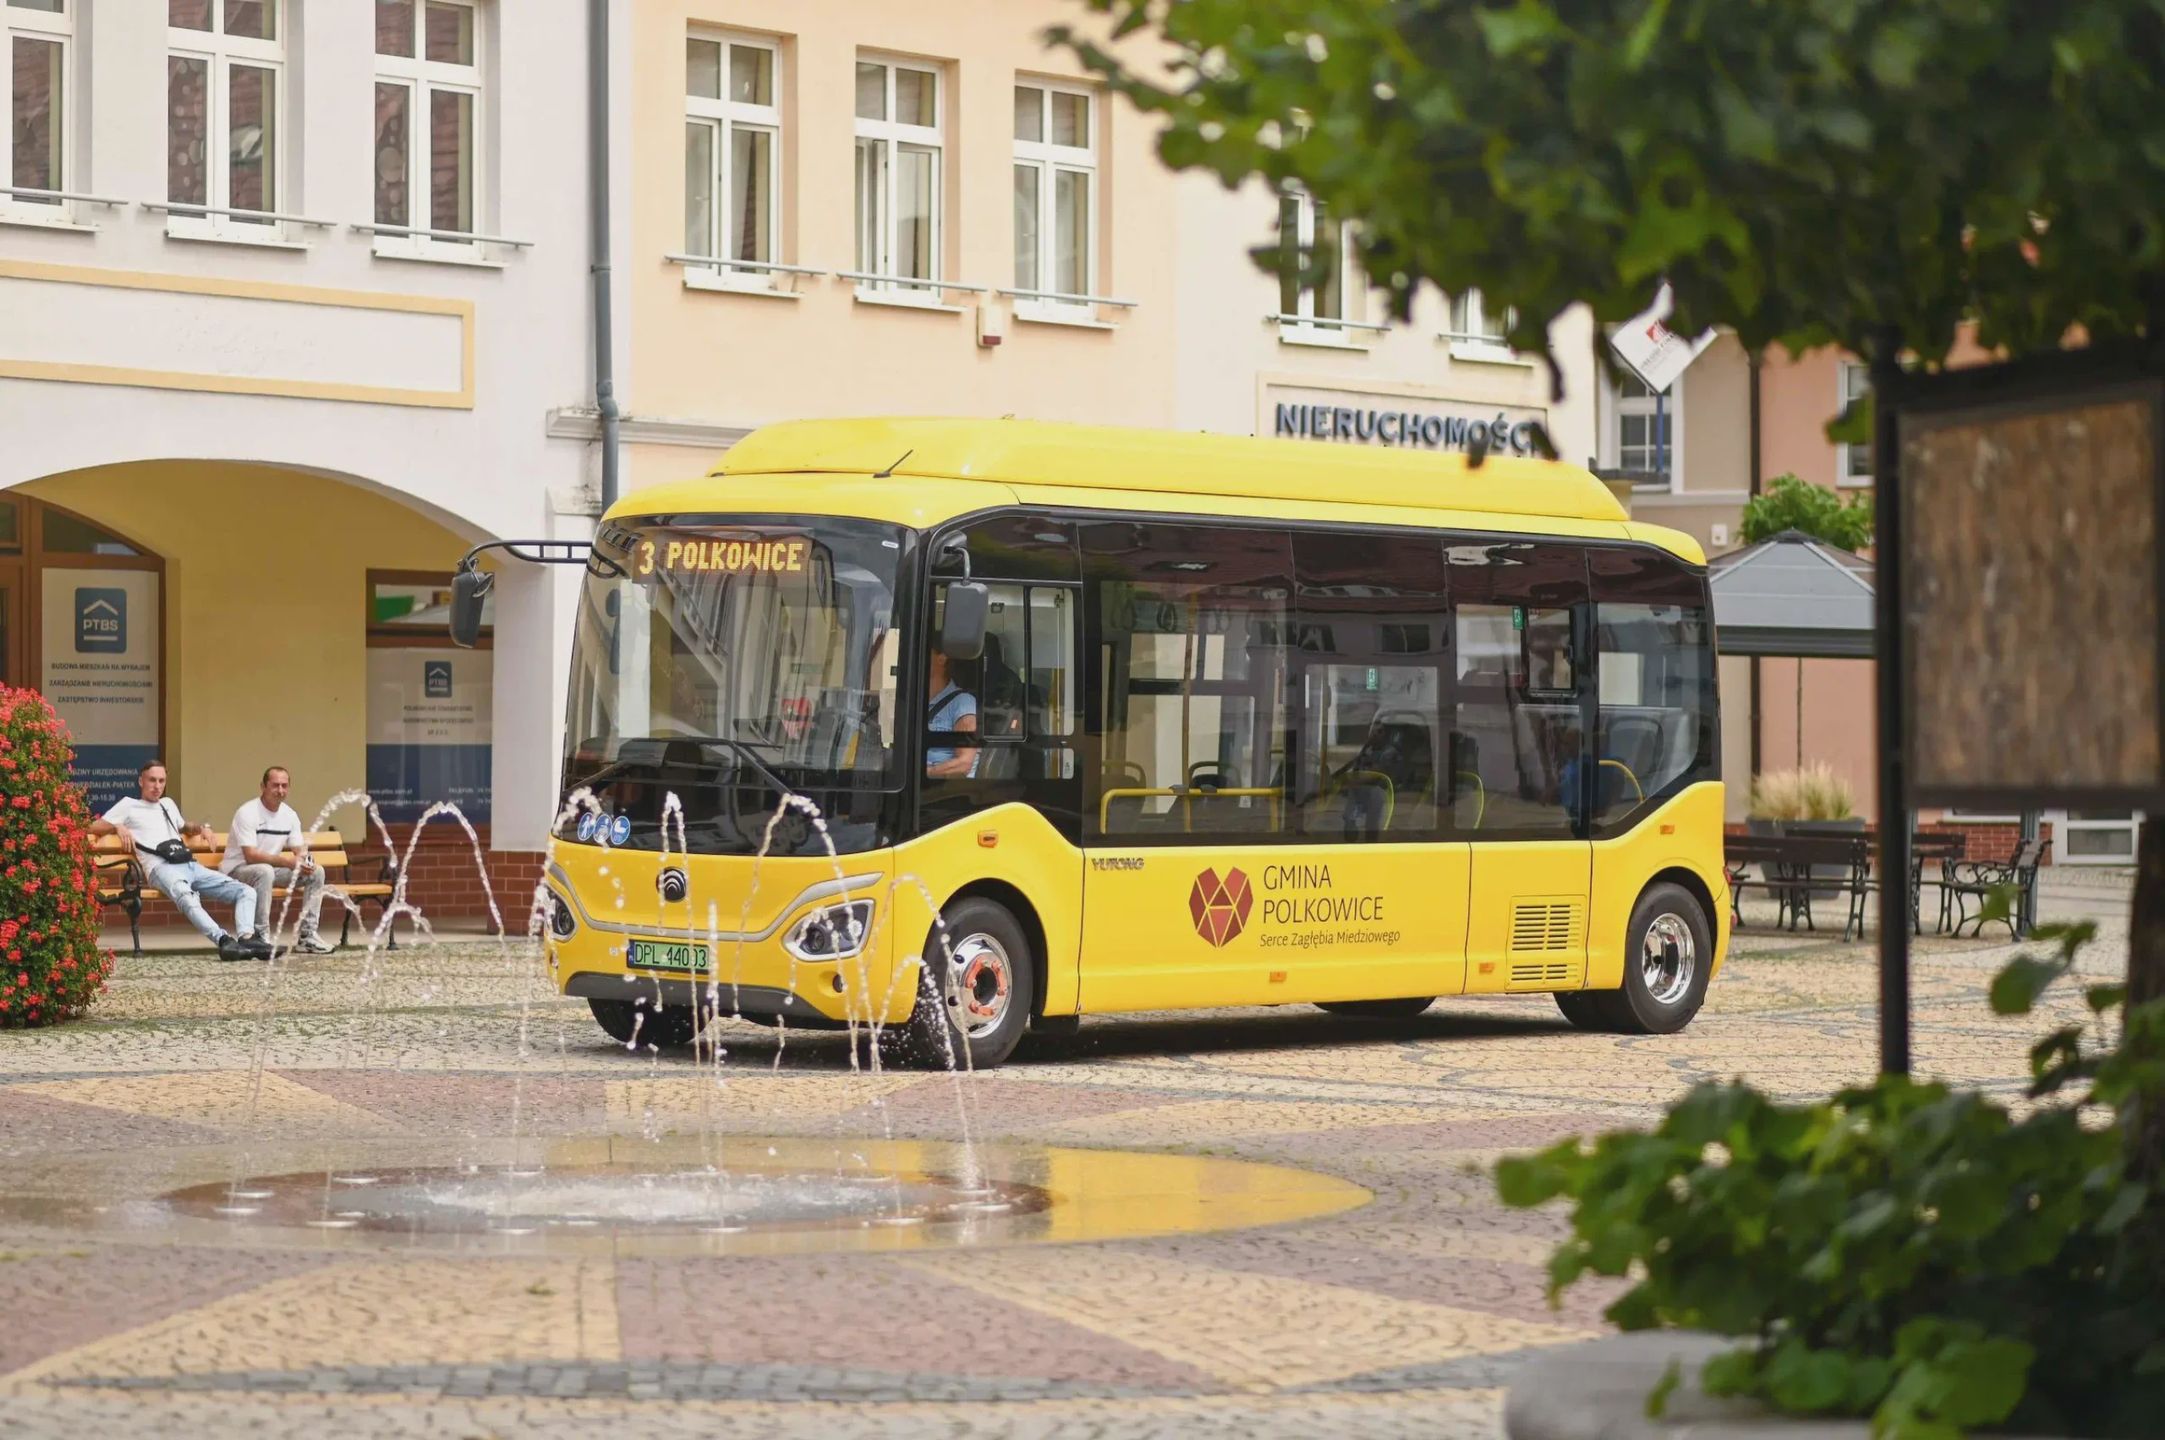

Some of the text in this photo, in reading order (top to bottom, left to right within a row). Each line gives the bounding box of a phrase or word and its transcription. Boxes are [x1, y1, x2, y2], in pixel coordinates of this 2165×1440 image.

[1275, 402, 1540, 456] NIERUCHOMOŚC
[639, 541, 803, 575] 3 POLKOWICE
[83, 619, 119, 631] PTBS
[1091, 857, 1144, 871] YUTONG
[1263, 864, 1332, 890] GMINA
[1263, 896, 1384, 924] POLKOWICE
[1260, 928, 1401, 949] Serce Zagłębia Miedziowego
[635, 943, 661, 965] DPL
